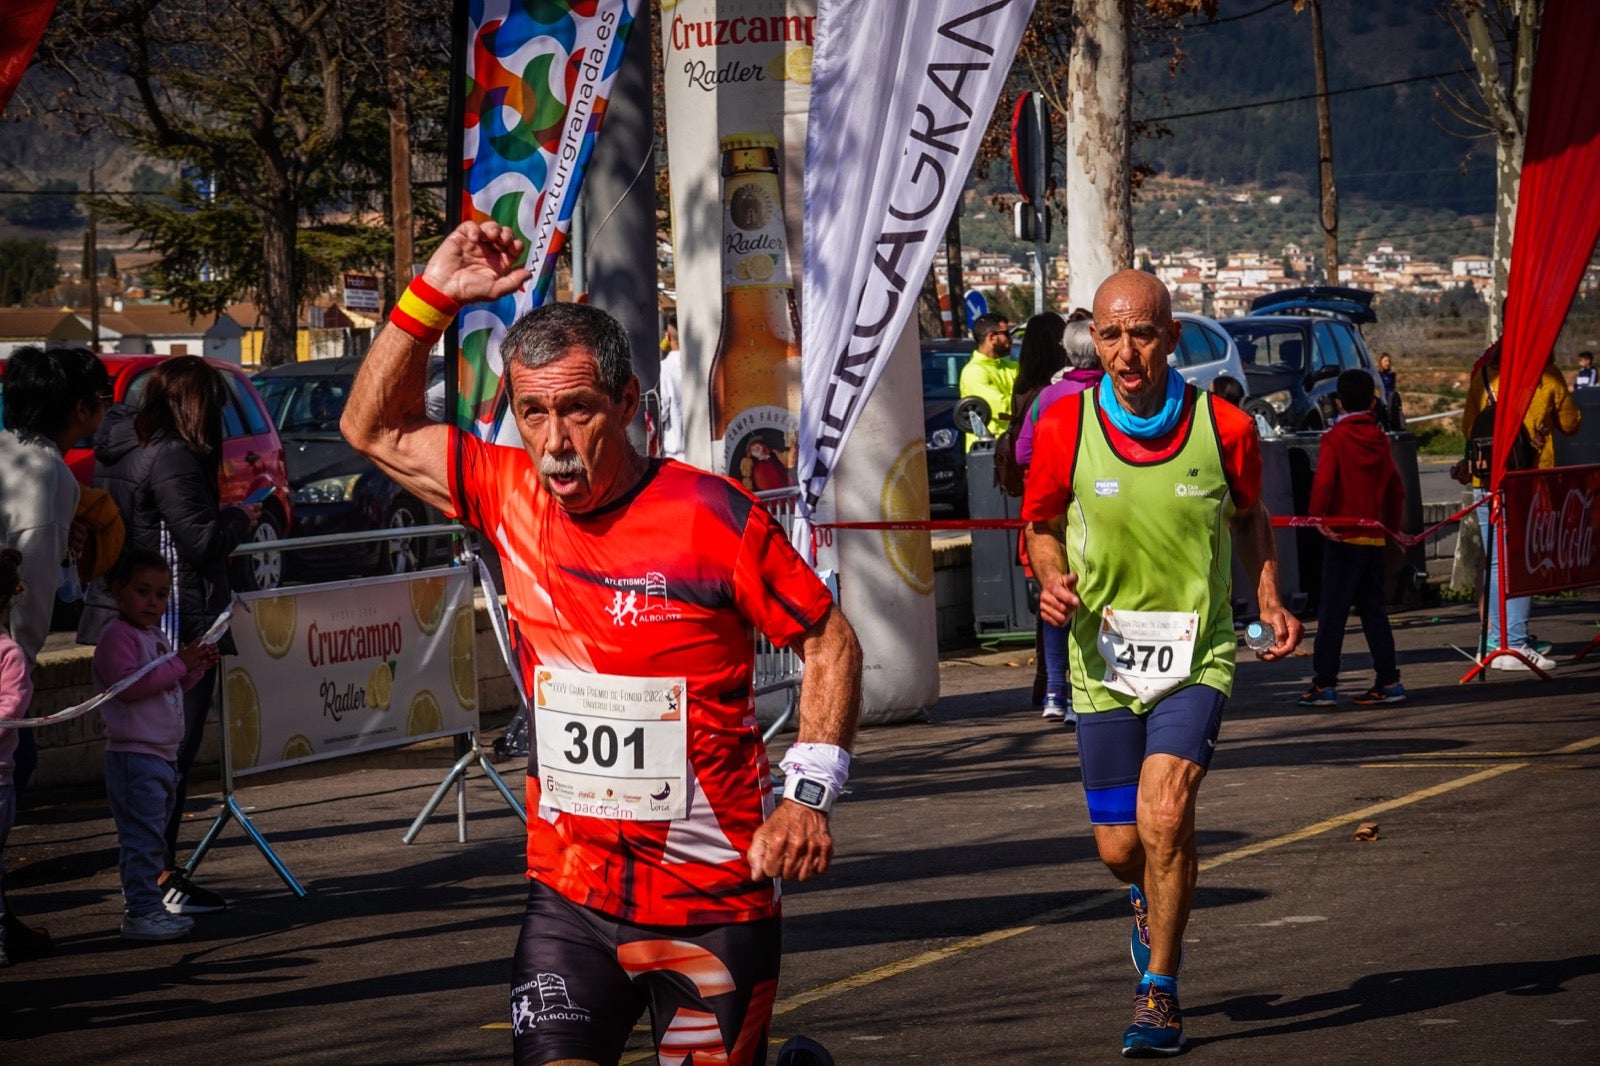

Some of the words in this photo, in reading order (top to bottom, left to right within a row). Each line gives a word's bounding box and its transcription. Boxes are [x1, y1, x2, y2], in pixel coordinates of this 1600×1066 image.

[672, 14, 817, 51] Cruzcamp
[684, 58, 766, 92] Radler
[528, 10, 615, 277] www.turgranada.es
[725, 232, 785, 254] Radler
[604, 577, 646, 587] ATLETISMO
[639, 613, 682, 623] ALBOLOTE
[307, 620, 402, 666] Cruzcampo
[1116, 643, 1173, 673] 470
[319, 676, 367, 723] Radler
[620, 689, 643, 702] FONDO
[564, 721, 644, 770] 301
[536, 1012, 591, 1023] ALBOLOTE
